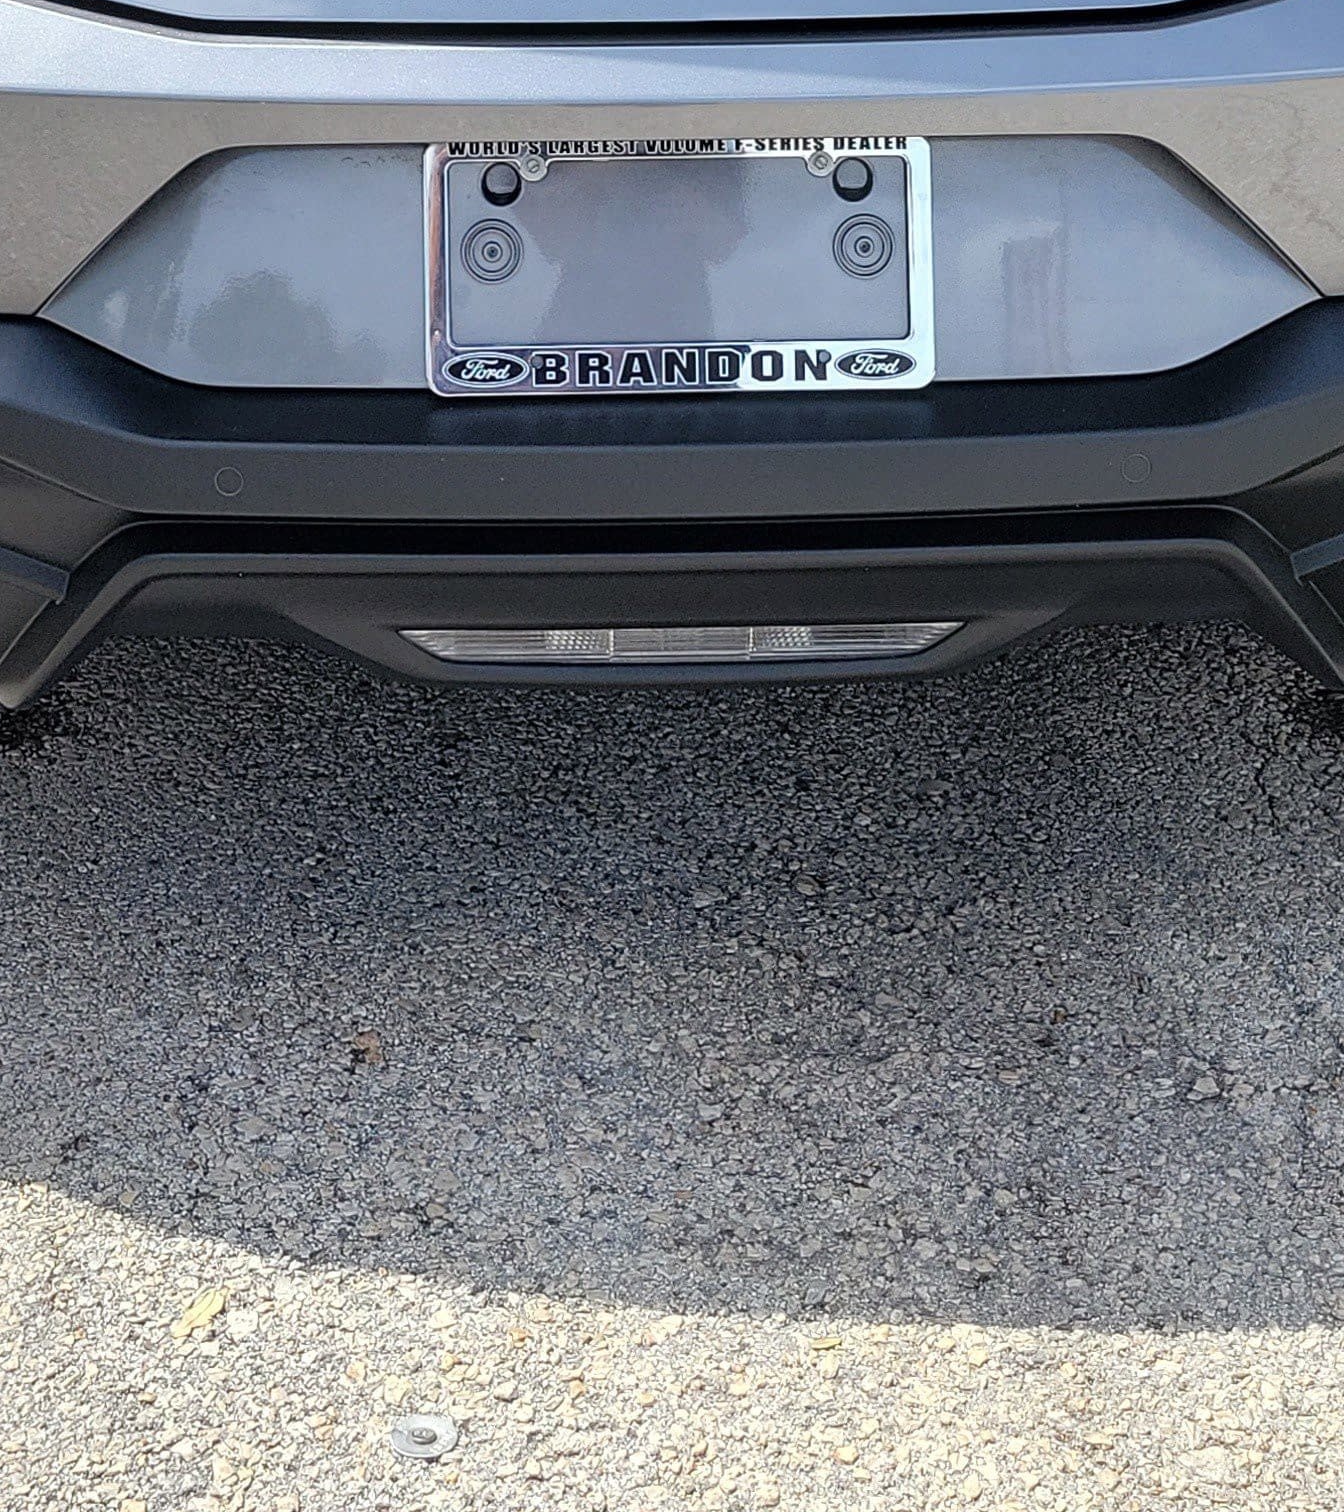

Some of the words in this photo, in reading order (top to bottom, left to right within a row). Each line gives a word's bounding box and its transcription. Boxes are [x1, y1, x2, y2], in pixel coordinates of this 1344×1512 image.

[447, 141, 540, 155] WORLD'S
[547, 140, 638, 154] LARGEST
[645, 138, 728, 152] VOLUME
[734, 137, 825, 151] F-SERIES
[833, 136, 907, 151] DEALER
[460, 358, 512, 380] Ford
[532, 349, 828, 387] BRANDON
[850, 353, 900, 375] Ford
